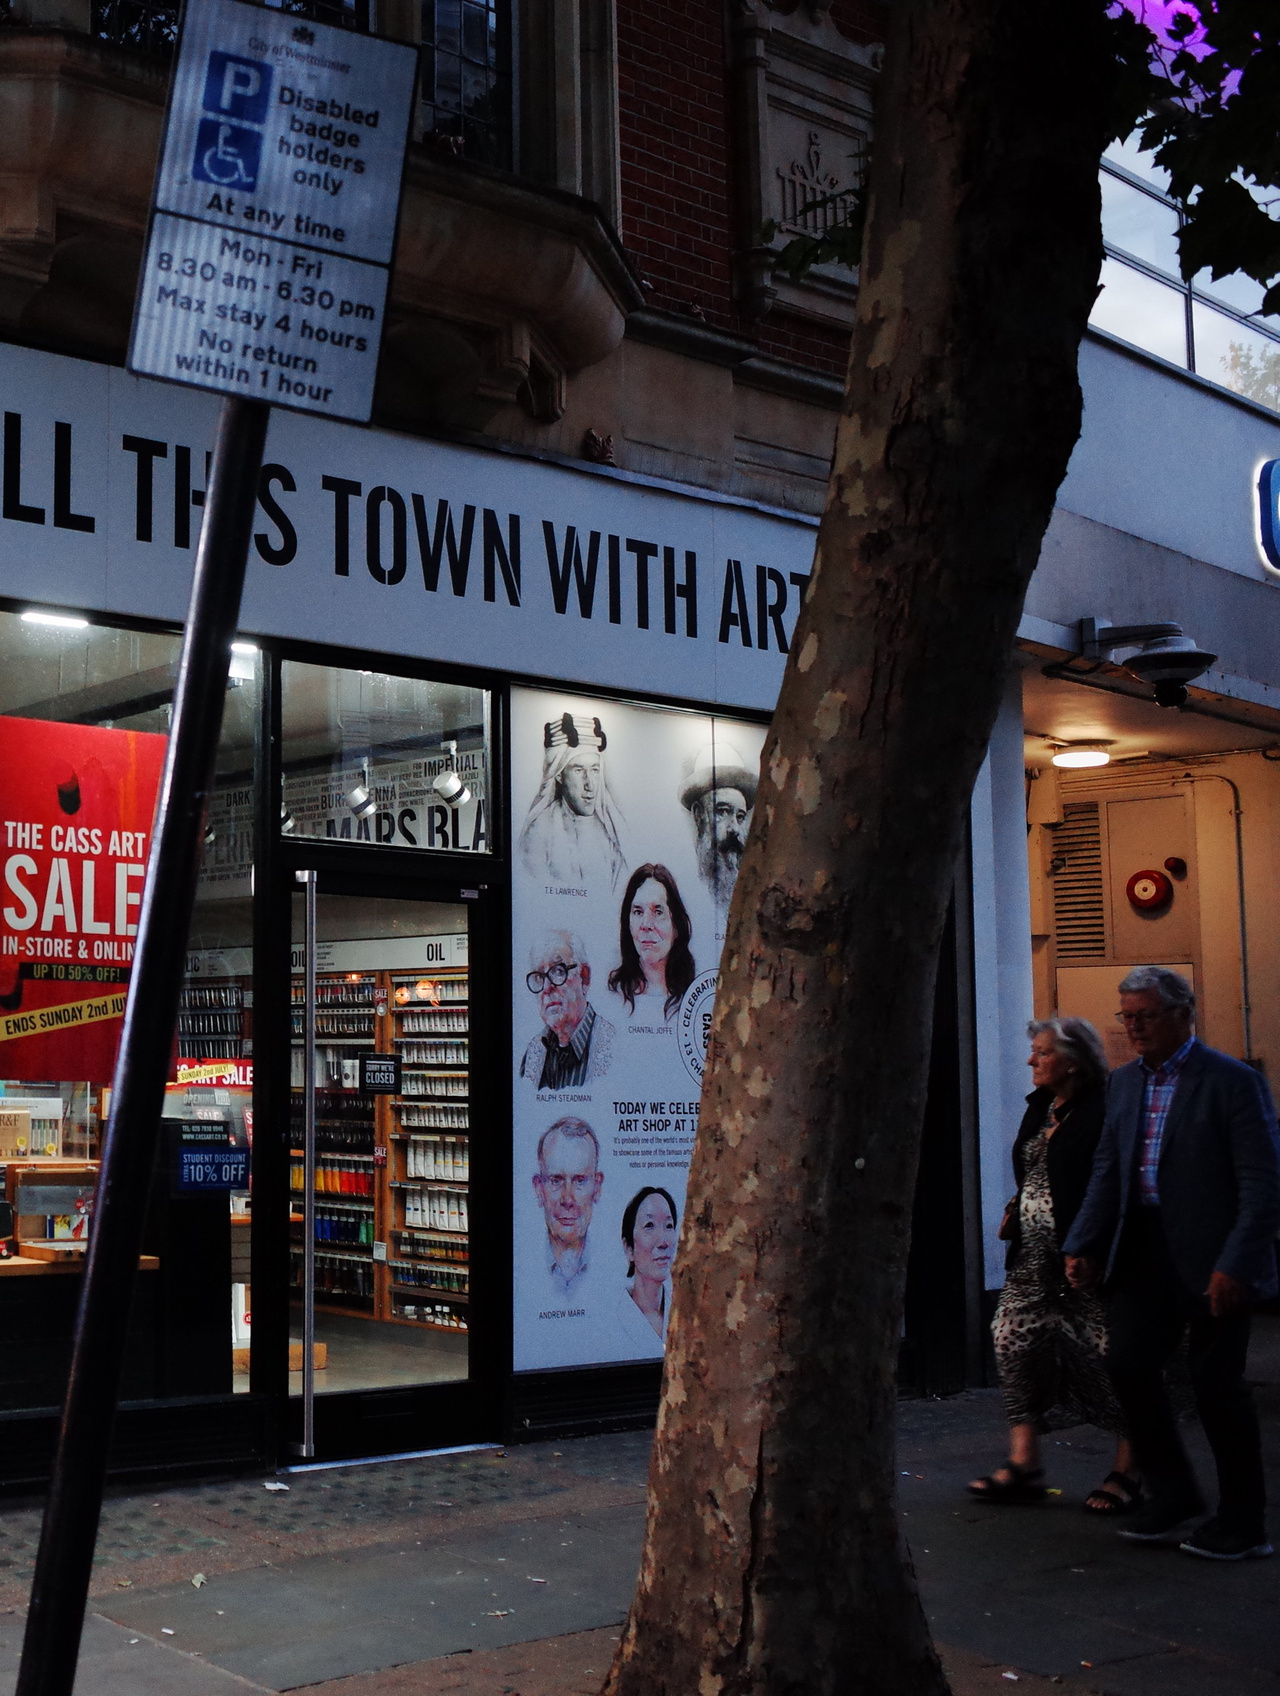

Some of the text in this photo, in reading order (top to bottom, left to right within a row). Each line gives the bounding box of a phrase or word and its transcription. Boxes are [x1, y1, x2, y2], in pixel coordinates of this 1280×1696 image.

[222, 61, 262, 111] P
[278, 86, 379, 128] Disabled
[290, 114, 360, 148] badge
[277, 135, 366, 174] holders
[293, 166, 344, 197] only
[206, 193, 346, 243] At any time
[220, 237, 323, 280] Mon Fri
[156, 252, 375, 323] 8.30 am 6.30 pm
[156, 286, 368, 352] Max stay 4 hours
[199, 329, 318, 374] No return
[175, 354, 333, 402] within 1 hour
[122, 434, 297, 567] THS
[321, 476, 521, 607] TOWN
[542, 520, 698, 639] WITH
[226, 790, 251, 808] DARK
[428, 799, 486, 850] BLA
[4, 821, 146, 858] THE CASS ART
[3, 854, 145, 936] SALE
[555, 888, 588, 898] LAWRENCE
[3, 936, 136, 961] IN-STORE & ONLIN
[426, 943, 445, 961] OIL
[33, 964, 121, 982] UP TO 50% OFF!
[374, 988, 388, 998] SALE
[683, 976, 719, 1028] CELEBRATIN
[5, 1015, 37, 1036] ENDS
[40, 1005, 83, 1028] SUNDAY
[88, 999, 109, 1018] 2nd
[628, 1026, 673, 1035] CHANTAL JOFFE
[684, 1041, 693, 1056] 13
[181, 1070, 202, 1081] SUNDAY
[366, 1063, 380, 1072] SORRY
[366, 1072, 395, 1084] CLOSED
[536, 1094, 592, 1103] RALPH STEADMAN
[612, 1101, 647, 1114] TODAY
[649, 1102, 666, 1115] WE
[0, 1114, 20, 1127] R&F
[618, 1119, 639, 1132] ART
[642, 1119, 671, 1132] SHOP
[674, 1119, 686, 1132] AT
[621, 1136, 641, 1145] probably
[183, 1154, 246, 1163] STUDENT DISCOUNT
[374, 1147, 387, 1157] SALE
[189, 1164, 246, 1182] 10% OFF
[538, 1308, 586, 1320] ANDREW MARR
